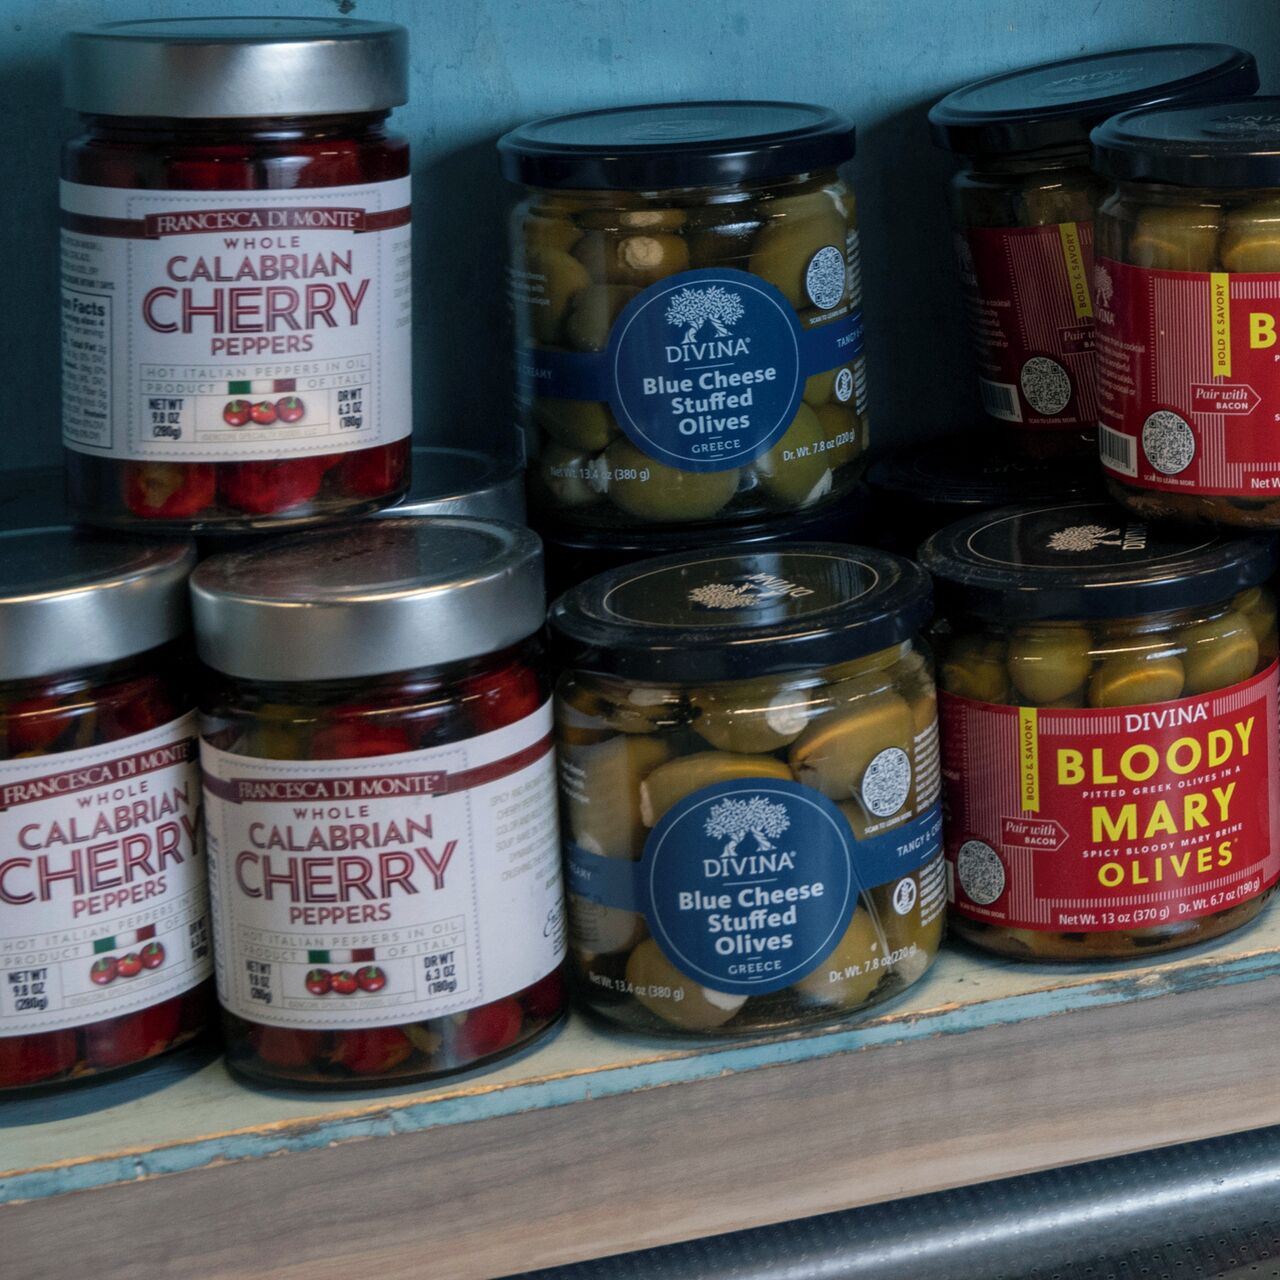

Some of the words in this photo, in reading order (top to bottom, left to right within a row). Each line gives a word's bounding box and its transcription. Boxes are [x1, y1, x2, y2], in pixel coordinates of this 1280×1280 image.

[157, 210, 263, 233] FRANCESCA
[267, 211, 289, 227] DI
[291, 210, 356, 227] MONTE
[224, 236, 300, 250] WHOLE
[166, 250, 353, 282] CALABRIAN
[142, 279, 371, 334] CHERRY
[211, 333, 314, 357] PEPPERS
[665, 340, 749, 363] DIVINA
[643, 377, 693, 396] Blue
[698, 367, 777, 392] Cheese
[671, 388, 754, 416] Stuffed
[678, 411, 751, 436] Olives
[691, 439, 741, 454] GREECE
[1125, 704, 1208, 733] DIVINA
[1056, 716, 1255, 786] BLOODY
[3, 767, 113, 804] FRANCESCA
[117, 760, 139, 779] DI
[140, 744, 190, 774] MONTE
[238, 781, 325, 799] FRANCESCA
[333, 781, 355, 798] DI
[360, 776, 434, 796] MONTE
[77, 781, 149, 809] WHOLE
[18, 781, 191, 851] CALABRIAN
[293, 805, 370, 819] WHOLE
[1091, 781, 1237, 843] MARY
[249, 814, 434, 851] CALABRIAN
[0, 810, 201, 905] CHERRY
[234, 839, 459, 903] CHERRY
[703, 854, 795, 878] DIVINA
[1097, 841, 1234, 887] OLIVES
[72, 876, 168, 918] PEPPERS
[678, 891, 732, 911] Blue
[737, 882, 825, 908] Cheese
[289, 903, 392, 925] PEPPERS
[707, 904, 797, 933] Stuffed
[714, 932, 793, 956] Olives
[728, 960, 782, 976] GREECE
